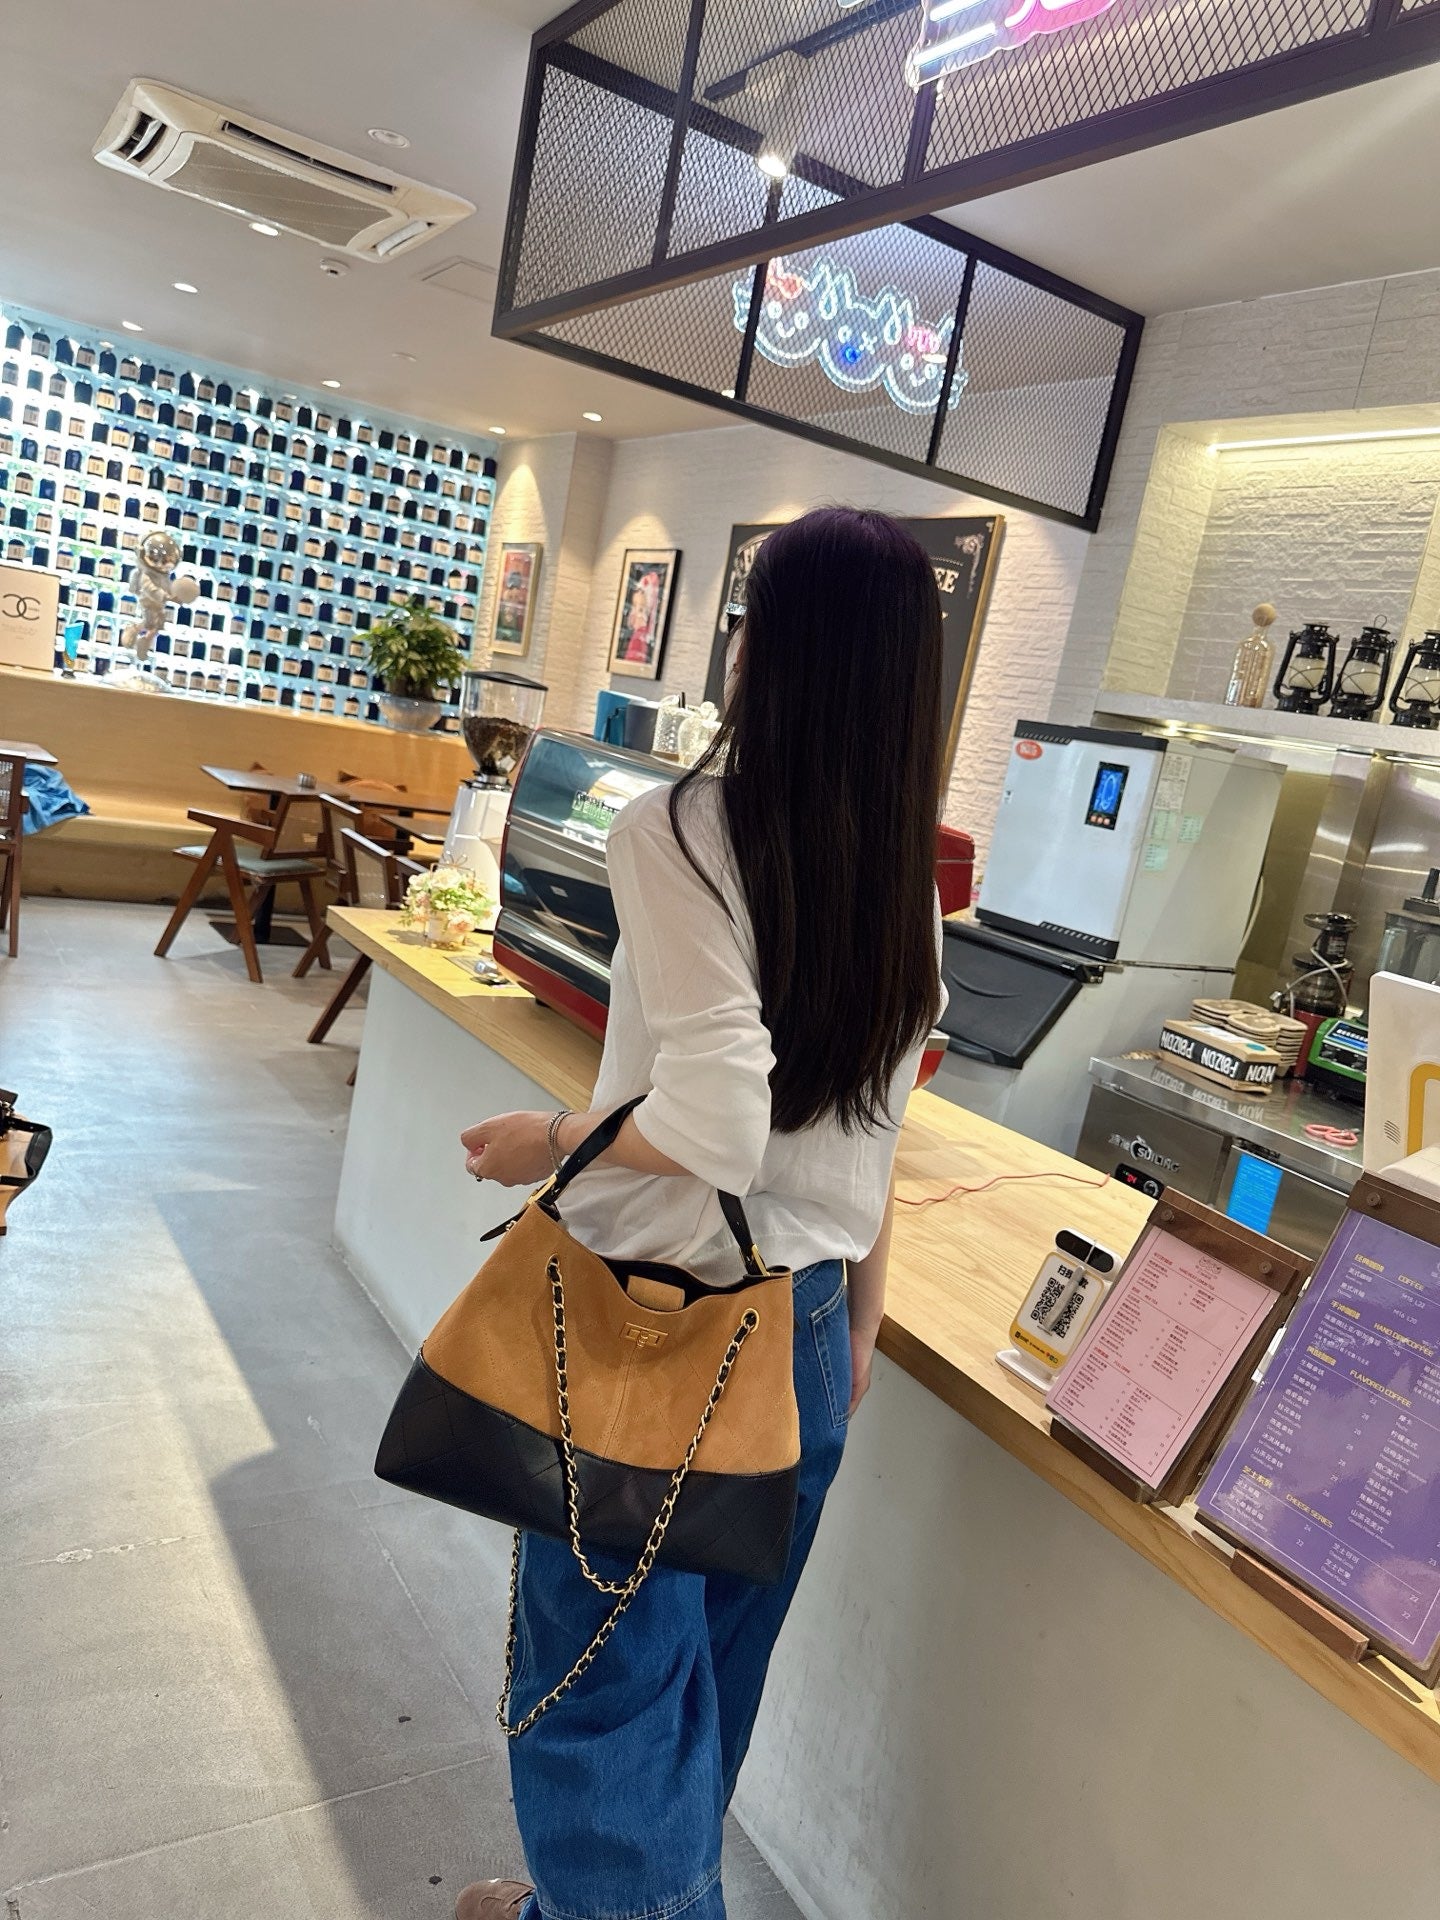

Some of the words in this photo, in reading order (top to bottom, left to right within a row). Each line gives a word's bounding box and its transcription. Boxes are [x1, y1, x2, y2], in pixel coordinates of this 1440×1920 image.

[1398, 1275, 1425, 1291] COFFEE
[1349, 1370, 1385, 1393] FLAVORED
[1384, 1389, 1412, 1408] COFFEE
[1286, 1494, 1311, 1513] CHEESE
[1309, 1509, 1334, 1529] SERIES
